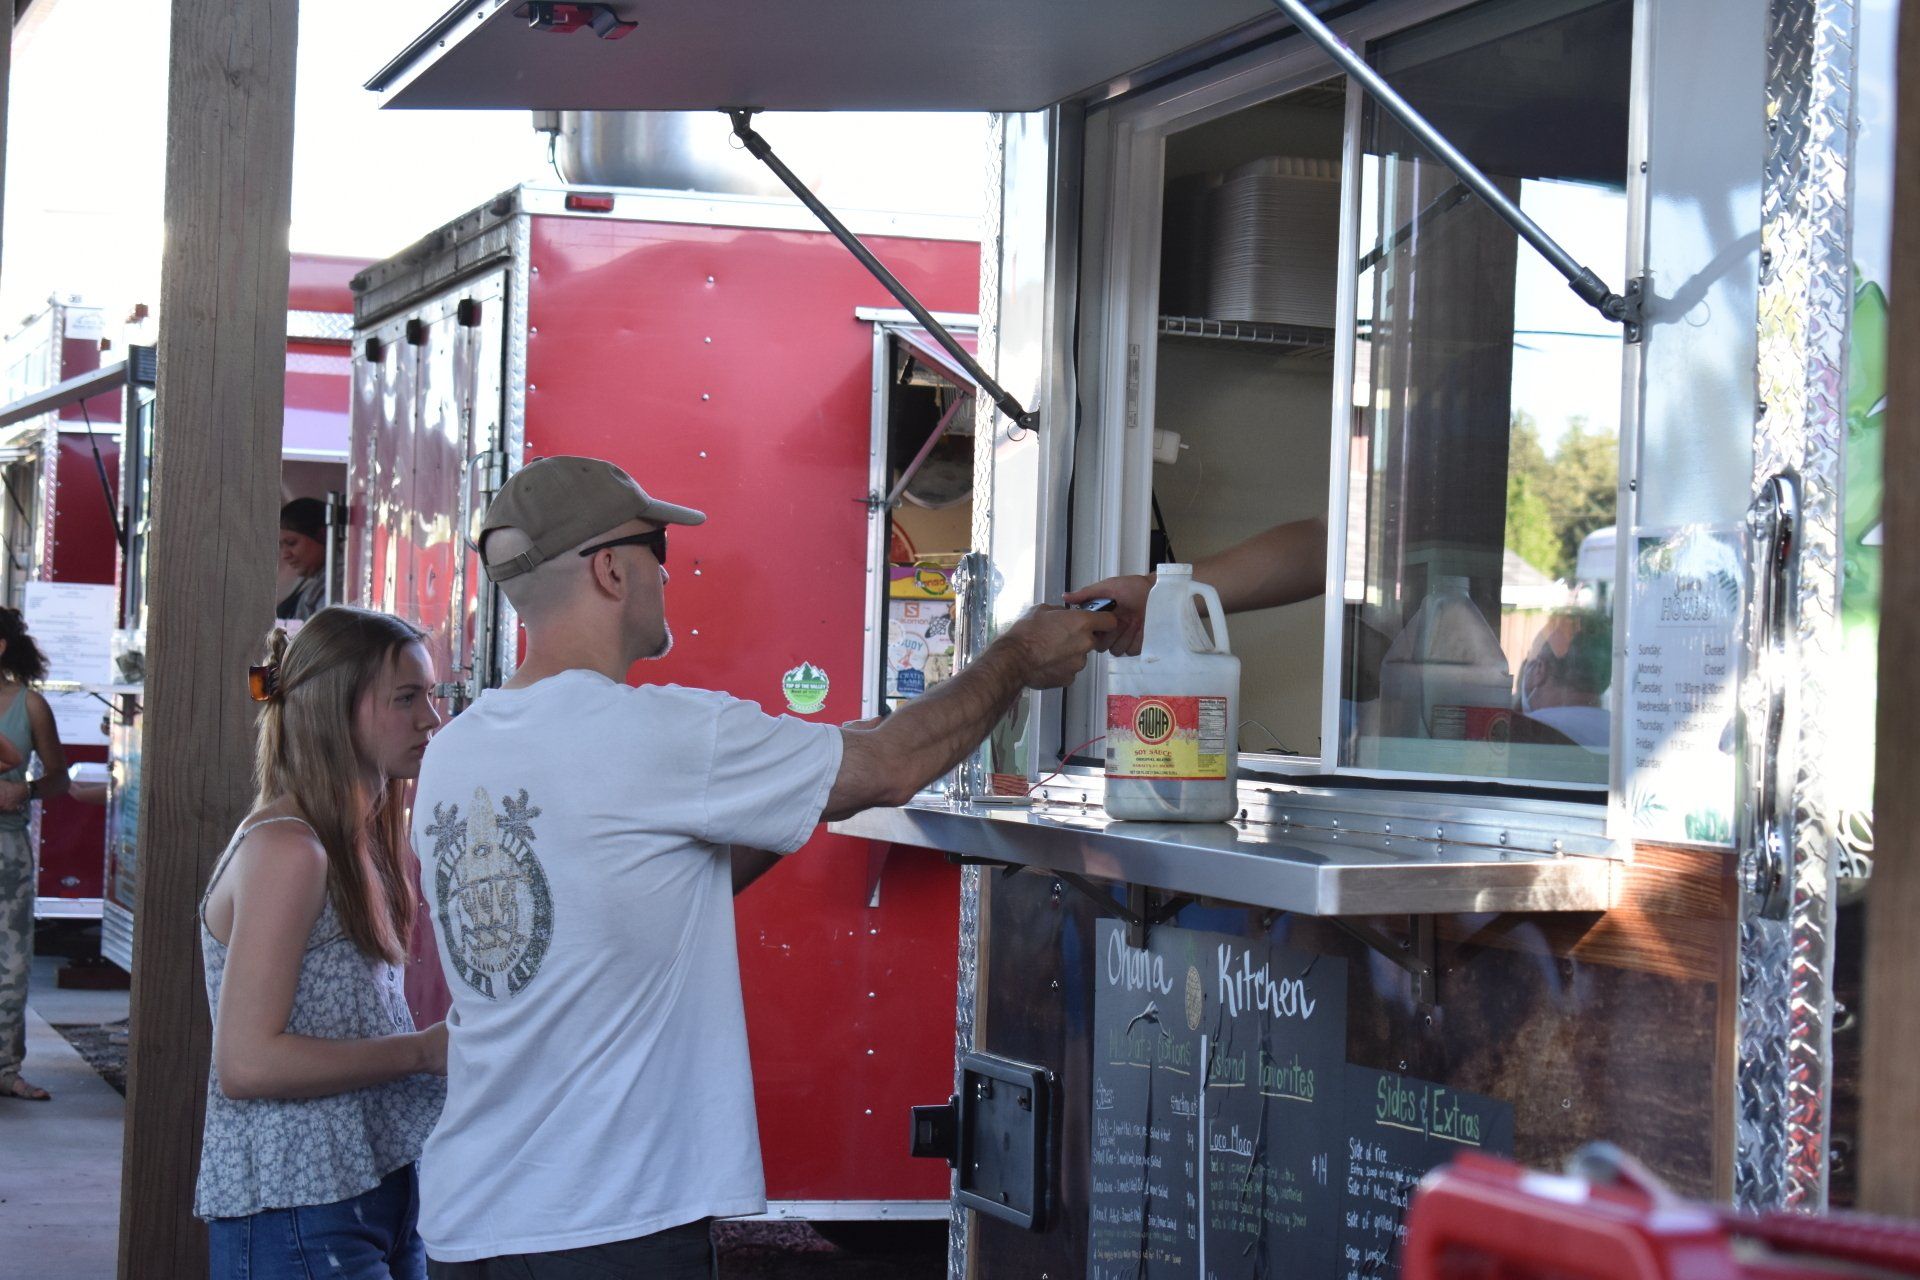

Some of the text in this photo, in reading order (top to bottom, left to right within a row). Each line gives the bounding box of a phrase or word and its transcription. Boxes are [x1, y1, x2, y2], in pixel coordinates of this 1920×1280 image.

[1661, 596, 1712, 622] HOURS
[1638, 644, 1725, 658] Sunday: Closed
[1704, 663, 1725, 676] Closed
[1138, 706, 1170, 739] ALOHA
[1148, 749, 1173, 758] SAUCE
[1108, 929, 1174, 996] Ohana
[1217, 943, 1317, 1021] Kitchen
[1209, 1041, 1315, 1098] Island Favorites
[1376, 1075, 1416, 1122] Sides
[1432, 1089, 1481, 1141] Extras
[1209, 1120, 1252, 1153] Loco Moco
[1349, 1137, 1363, 1160] Side
[1365, 1141, 1372, 1162] of
[1347, 1176, 1360, 1197] Side
[1362, 1178, 1371, 1197] of
[1373, 1184, 1388, 1202] Mac
[1362, 1209, 1371, 1230] of
